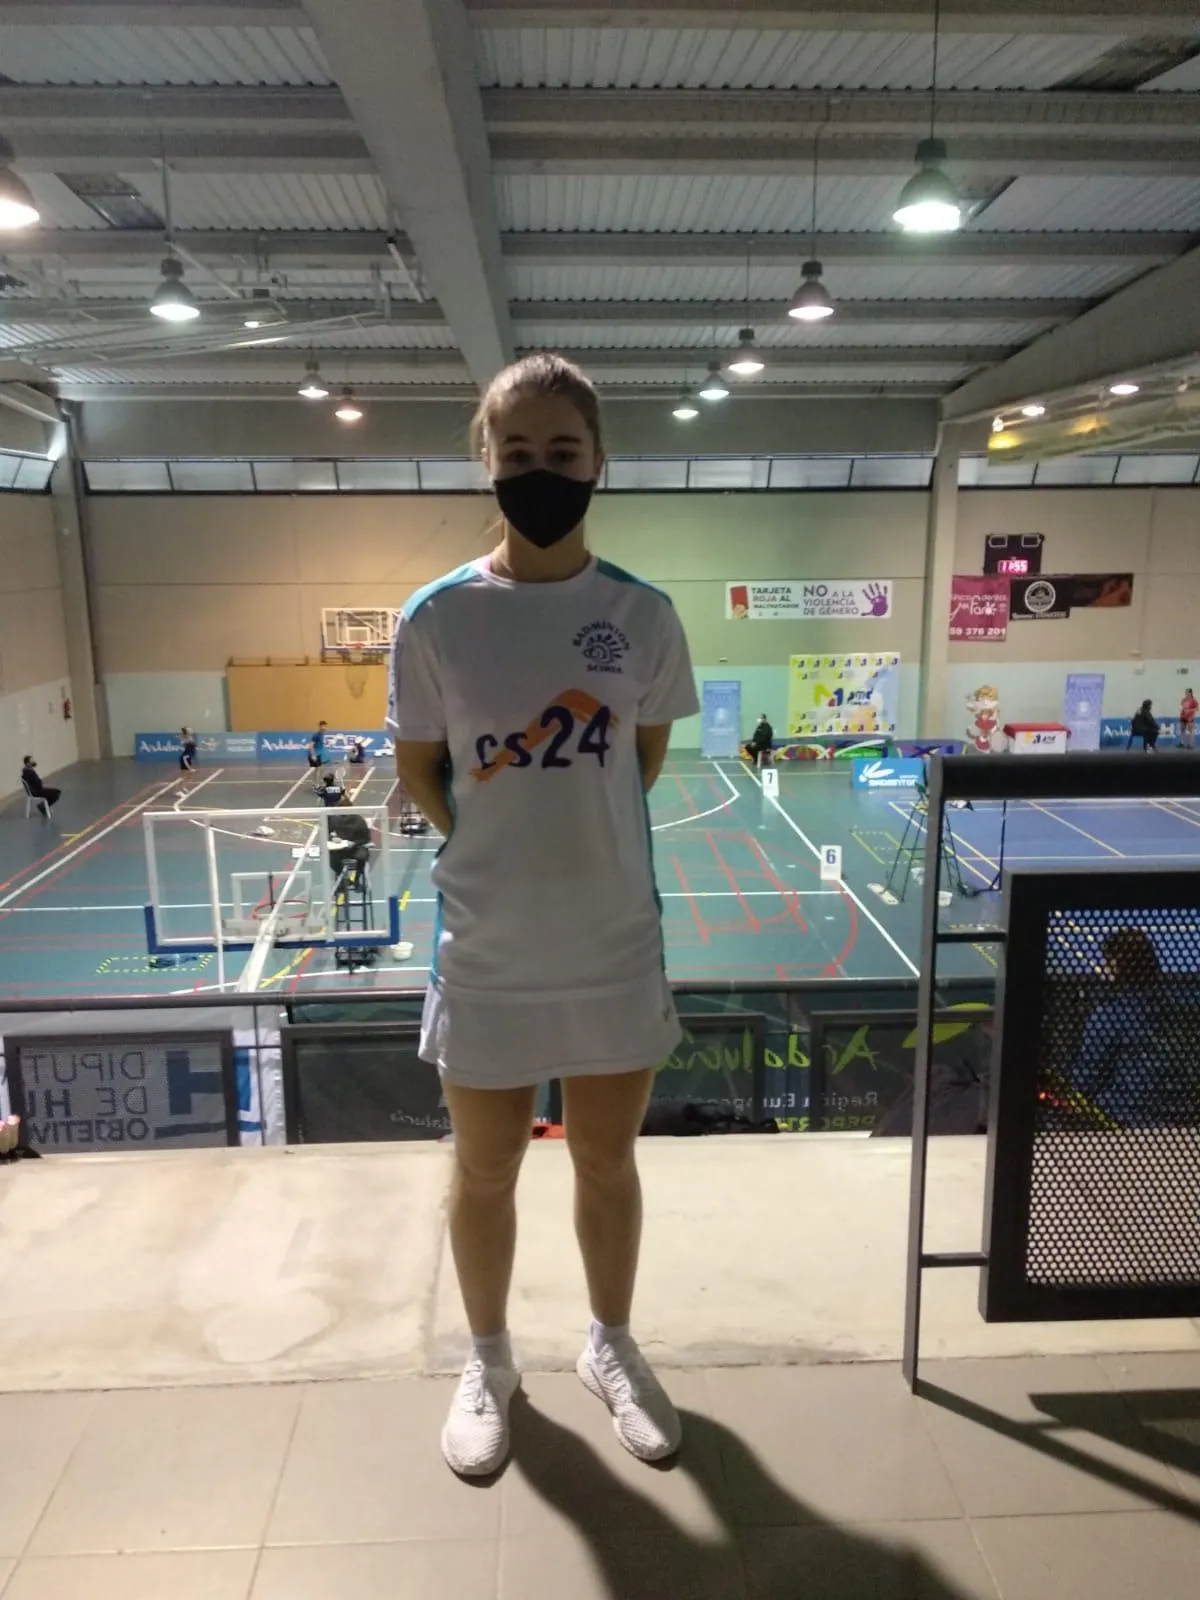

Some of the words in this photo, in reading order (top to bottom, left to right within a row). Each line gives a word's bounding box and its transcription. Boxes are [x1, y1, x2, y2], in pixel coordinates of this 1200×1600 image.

[803, 584, 828, 598] NO
[803, 598, 856, 606] VIOLENCIA
[803, 607, 815, 615] DE
[768, 772, 773, 784] 7
[826, 849, 836, 864] 6
